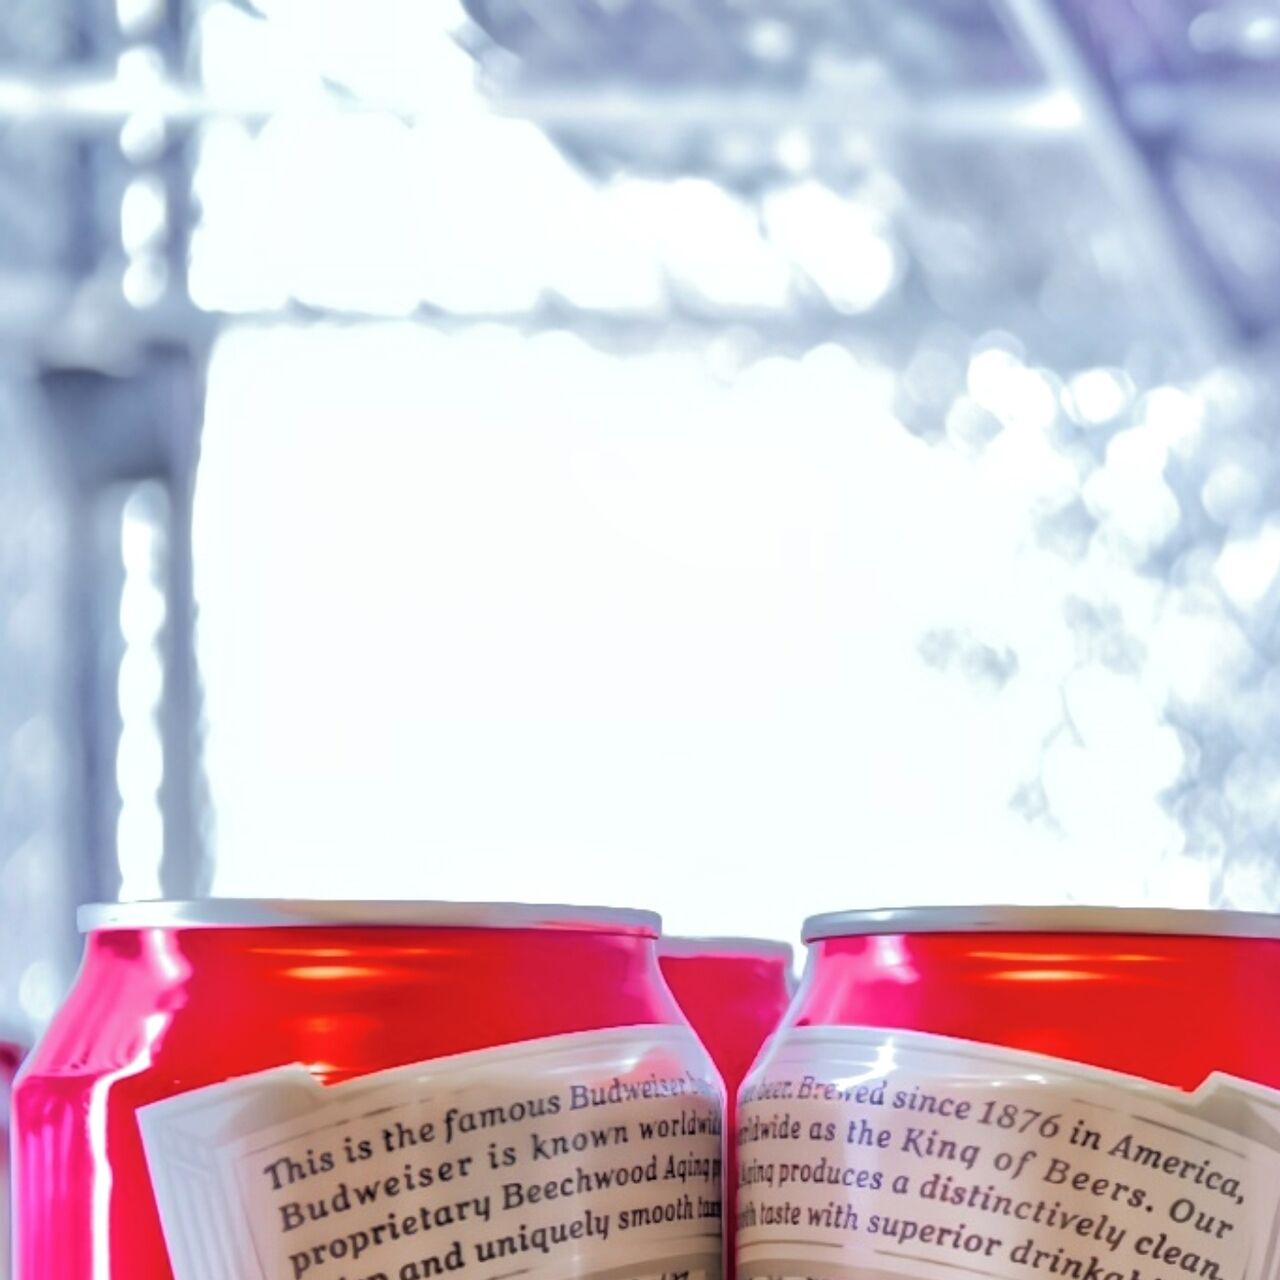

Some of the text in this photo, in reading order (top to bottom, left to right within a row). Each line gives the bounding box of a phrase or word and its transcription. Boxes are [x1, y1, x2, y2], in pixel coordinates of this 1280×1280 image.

[264, 1153, 335, 1192] This
[344, 1137, 373, 1163] is
[382, 1122, 436, 1152] the
[445, 1094, 561, 1144] famous
[280, 1154, 473, 1232] Budweiser
[487, 1143, 517, 1171] is
[531, 1126, 630, 1161] known
[809, 1121, 836, 1141] as
[847, 1119, 892, 1148] the
[901, 1127, 981, 1170] King
[993, 1150, 1038, 1180] of
[1043, 1158, 1154, 1213] Beers.
[1169, 1198, 1234, 1241] Our
[892, 1086, 971, 1120] since
[978, 1101, 1062, 1139] 1876
[1069, 1120, 1102, 1150] in
[1109, 1135, 1245, 1206] America,
[289, 1193, 491, 1280] proprietary
[502, 1155, 657, 1211] Beechwood
[474, 1211, 610, 1266] uniquely
[618, 1194, 693, 1230] smooth
[759, 1201, 801, 1226] taste
[807, 1201, 859, 1231] with
[867, 1213, 1003, 1257] superior
[778, 1157, 883, 1190] produces
[892, 1174, 910, 1195] a
[919, 1173, 1127, 1251] distinctively
